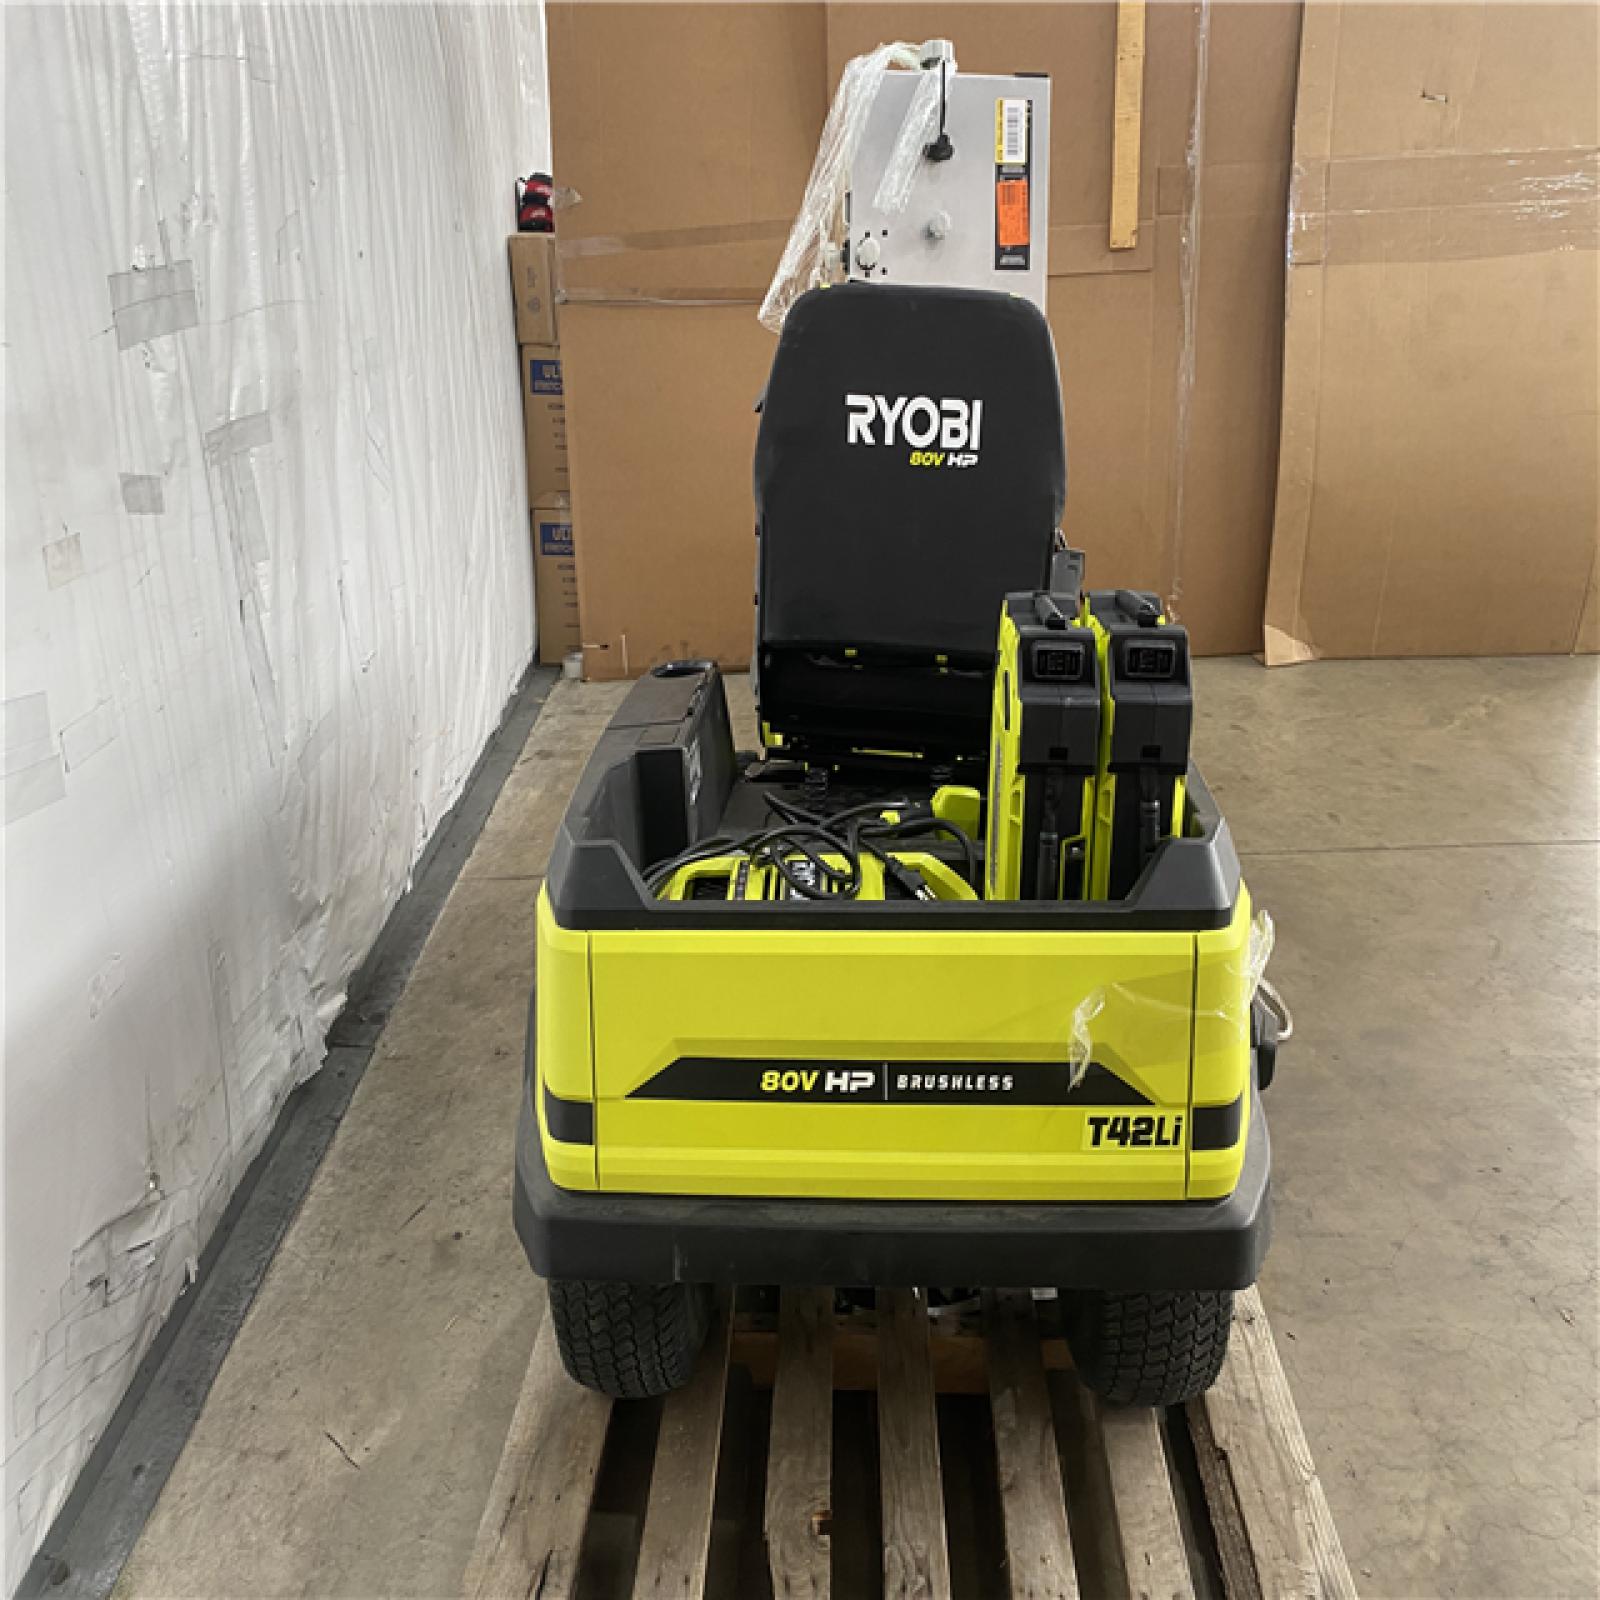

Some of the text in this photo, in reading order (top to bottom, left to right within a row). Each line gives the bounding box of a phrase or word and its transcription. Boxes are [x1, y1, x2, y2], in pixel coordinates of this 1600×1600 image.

[845, 394, 983, 450] RYOBI
[909, 452, 978, 468] 80V HP
[760, 1070, 1014, 1093] 80V HP BRUSHLESS
[1087, 1116, 1183, 1147] T42Li
